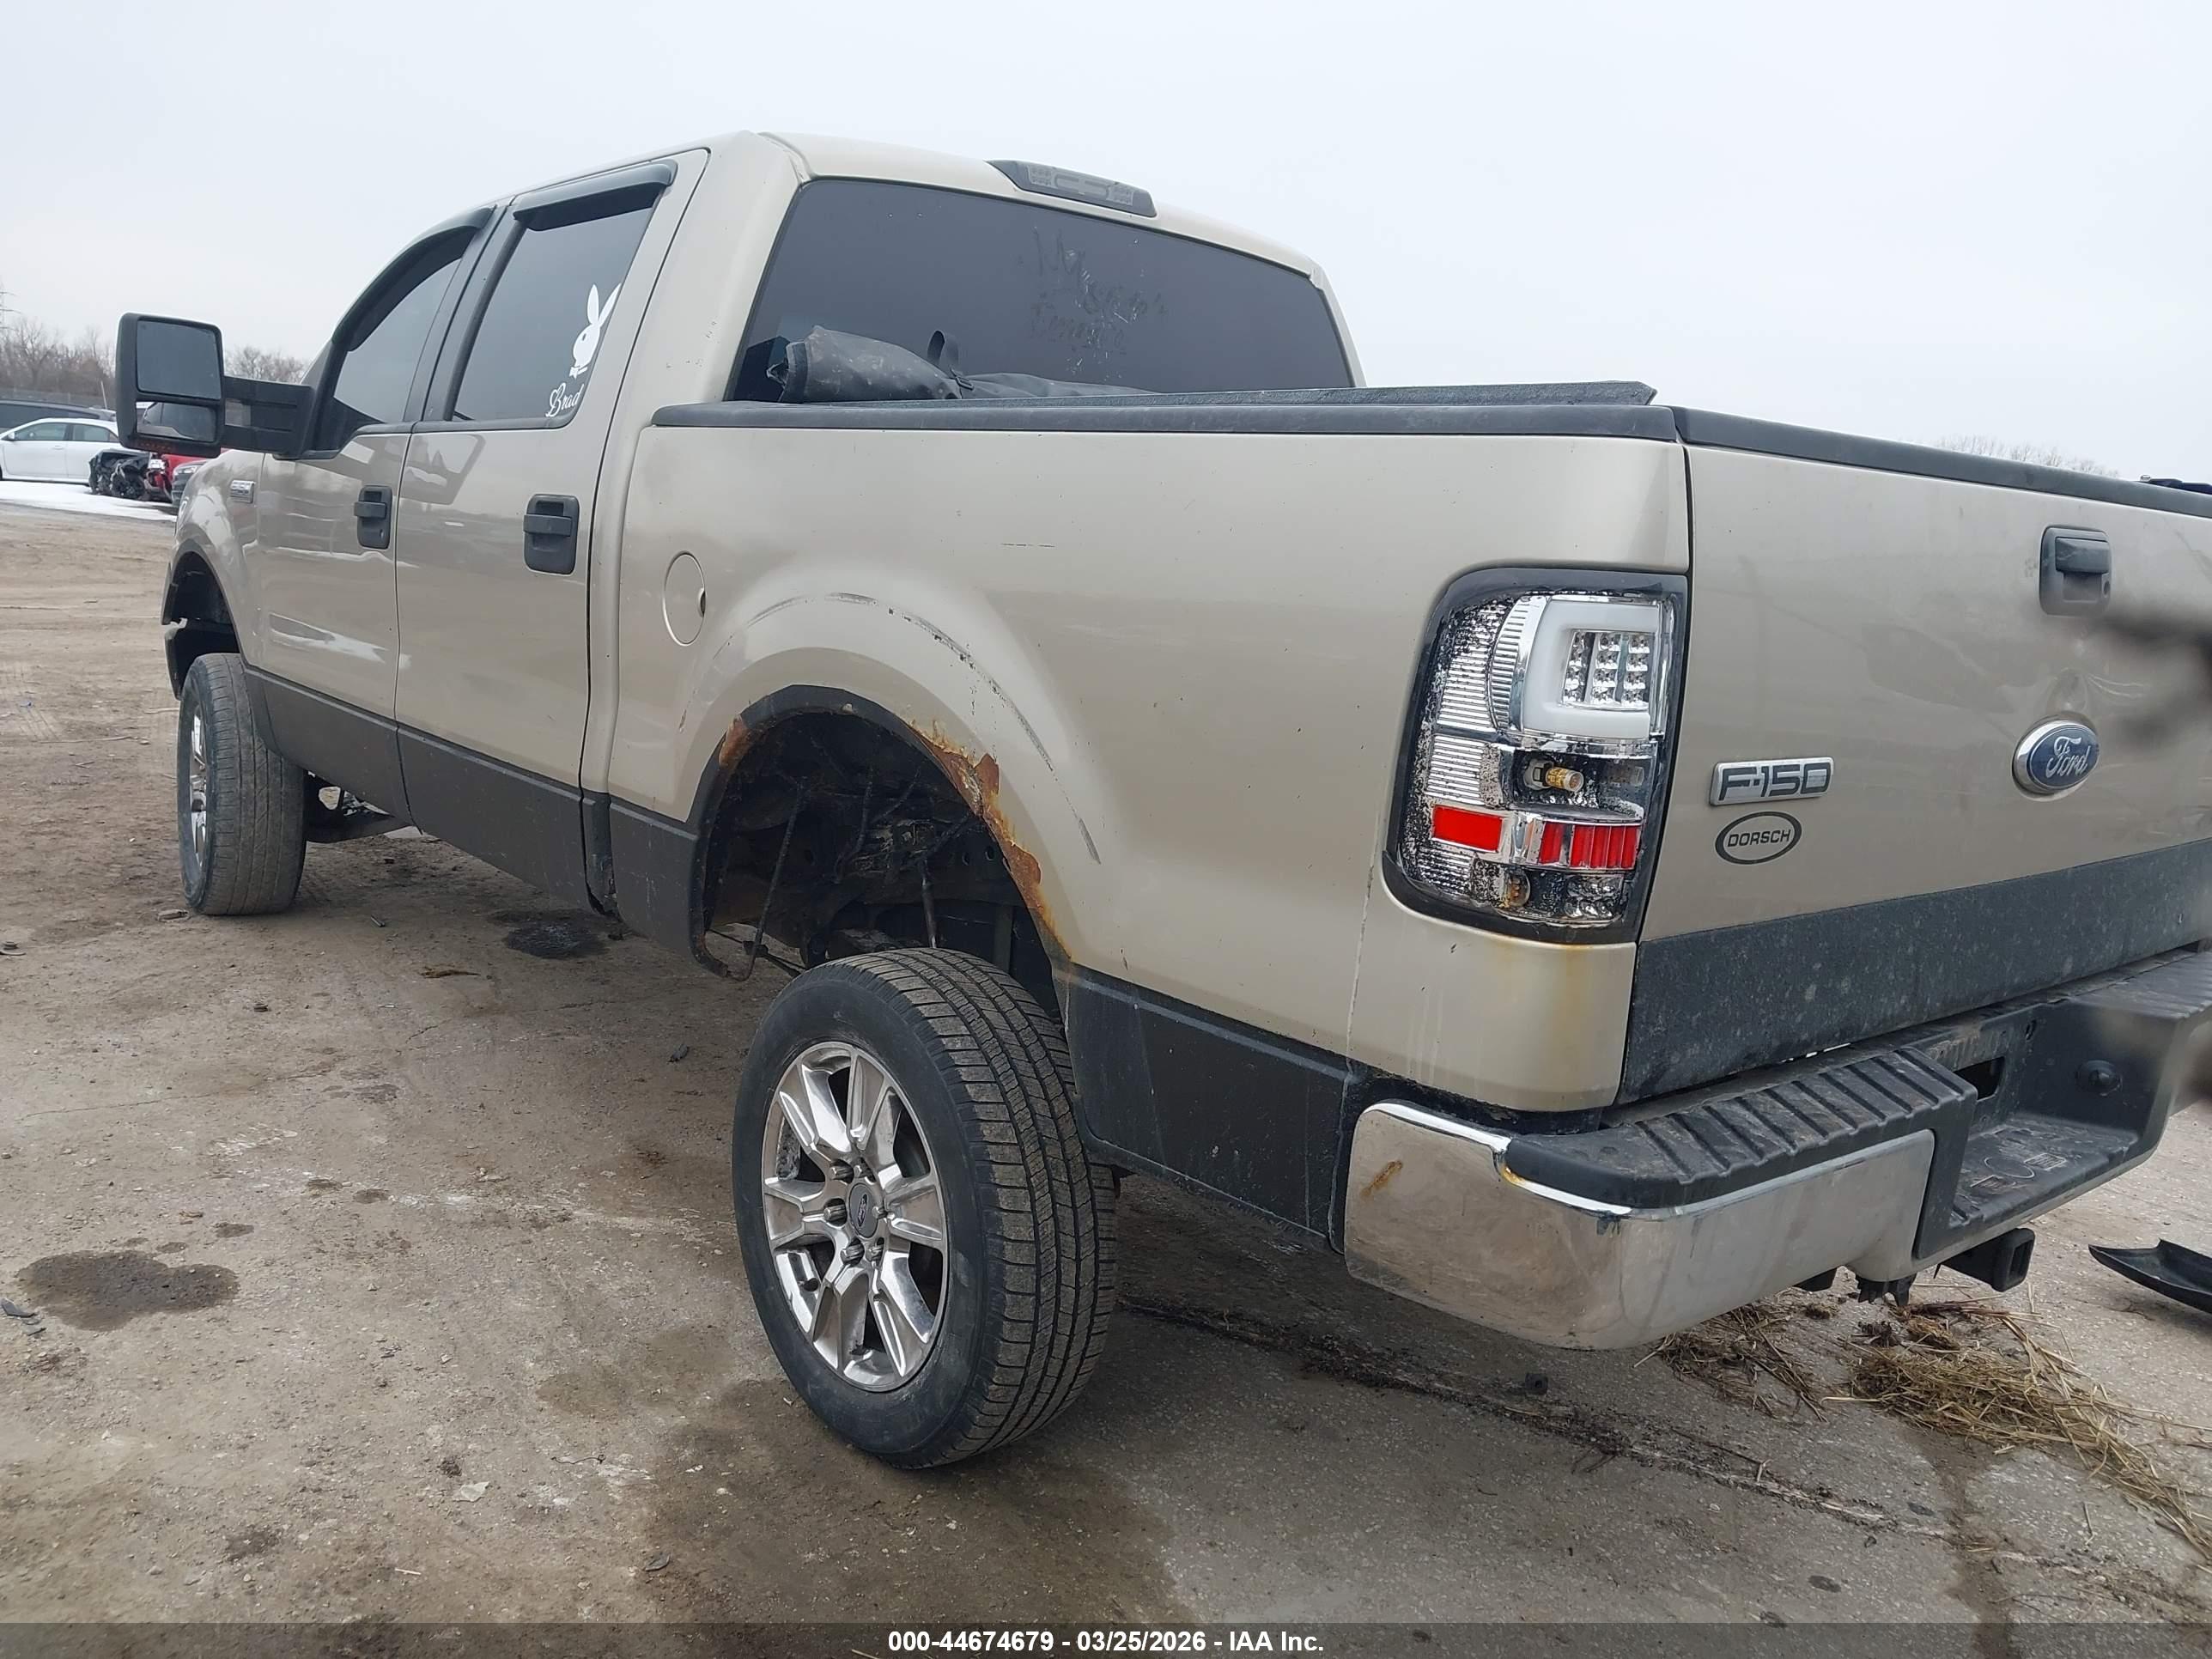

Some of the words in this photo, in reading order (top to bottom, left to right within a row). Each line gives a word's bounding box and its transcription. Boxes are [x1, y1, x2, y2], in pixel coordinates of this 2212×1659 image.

[545, 382, 585, 417] Brad
[2045, 736, 2091, 778] Ford
[1718, 762, 1831, 801] F-150
[1727, 829, 1792, 848] DORSCH
